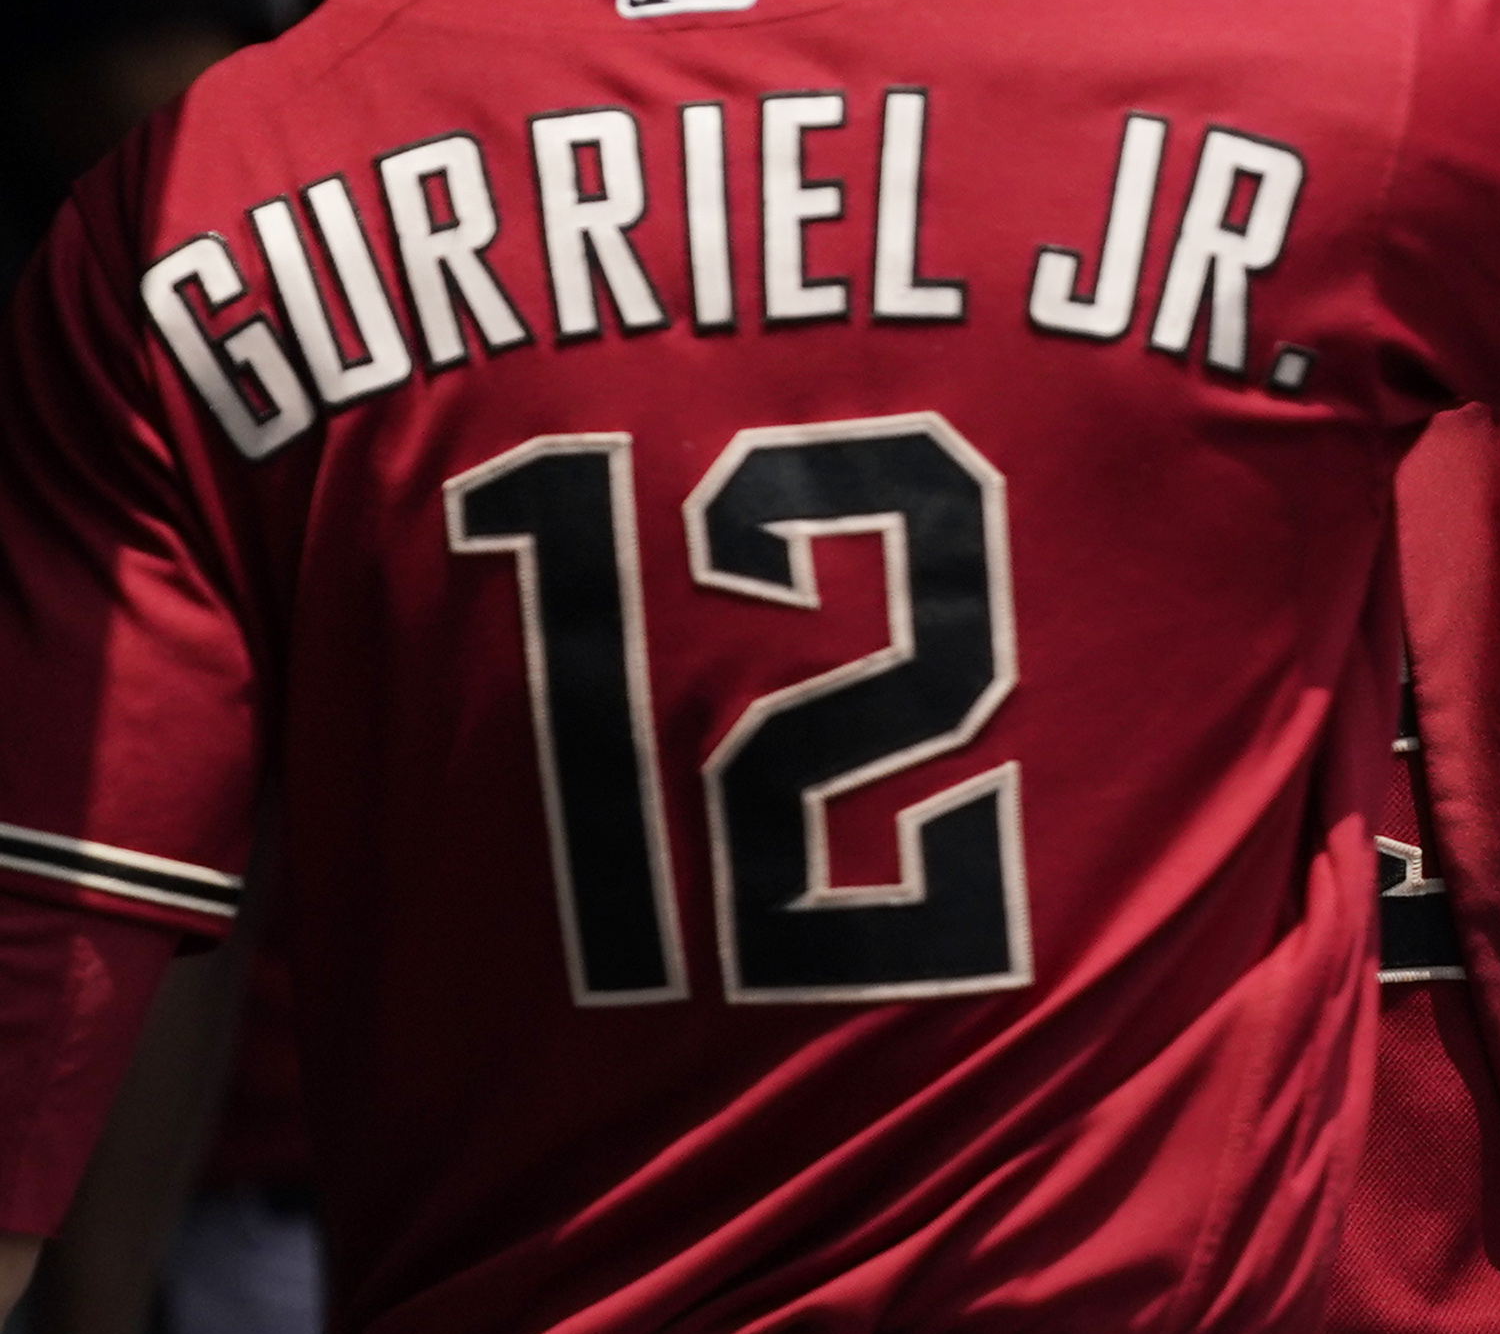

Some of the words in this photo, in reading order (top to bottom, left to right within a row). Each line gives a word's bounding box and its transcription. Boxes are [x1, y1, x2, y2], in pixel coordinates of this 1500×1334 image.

[138, 86, 967, 462] GURRIEL
[1029, 110, 1314, 393] JR.
[444, 410, 1034, 1005] 12
